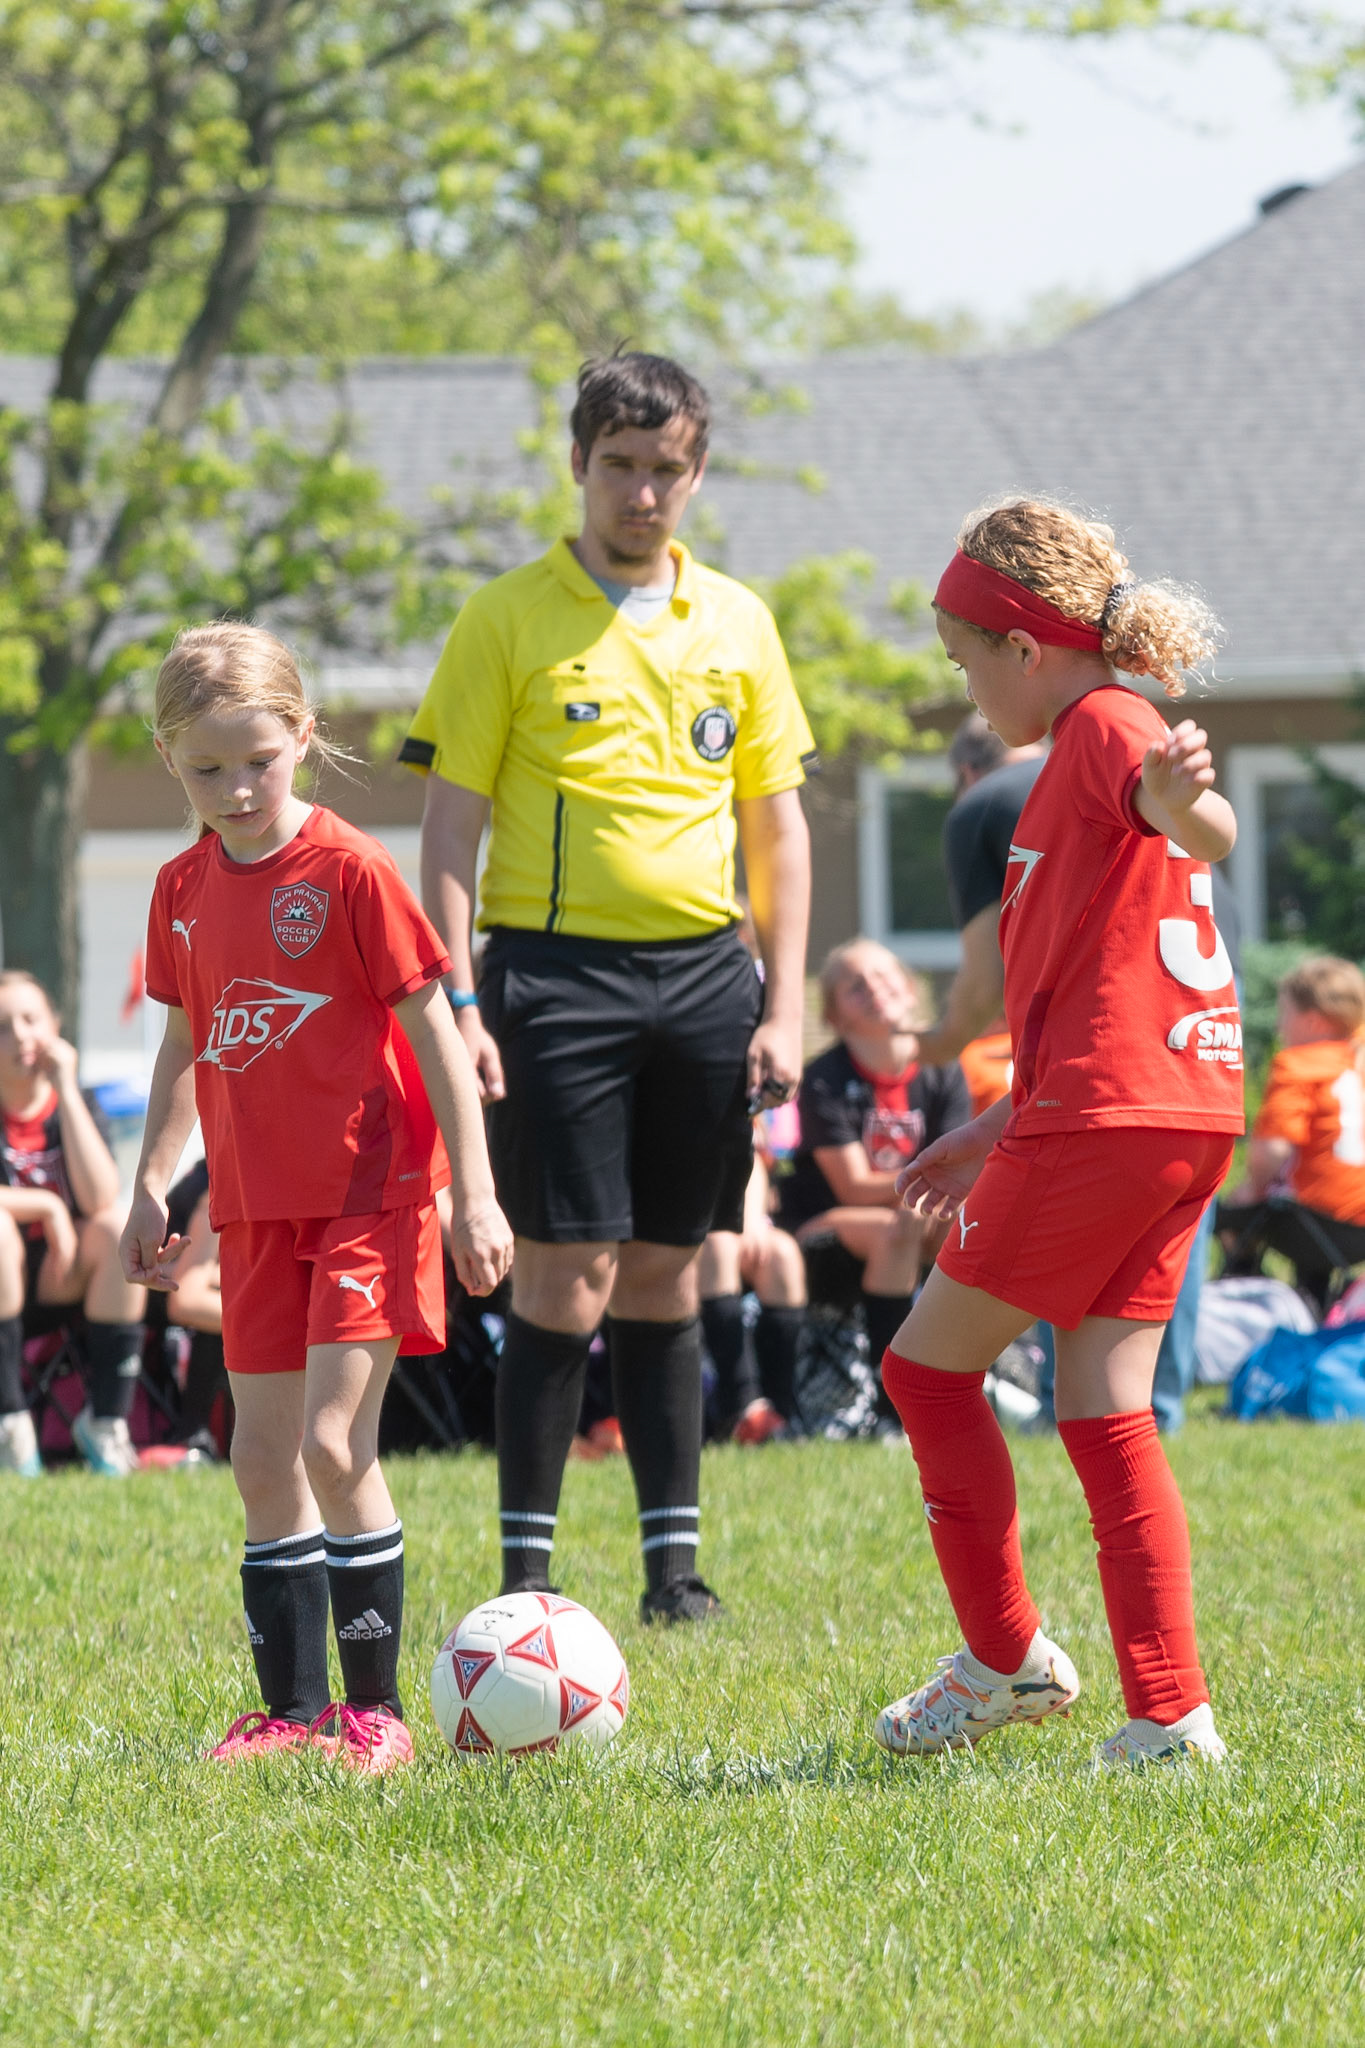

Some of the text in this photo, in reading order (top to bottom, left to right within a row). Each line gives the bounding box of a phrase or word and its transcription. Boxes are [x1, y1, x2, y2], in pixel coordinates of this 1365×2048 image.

[274, 888, 325, 913] SUN PRAIRIE
[276, 925, 317, 936] SOCCER
[281, 934, 309, 944] CLUB
[1197, 1048, 1239, 1063] MOTORS
[338, 1625, 393, 1641] adidas
